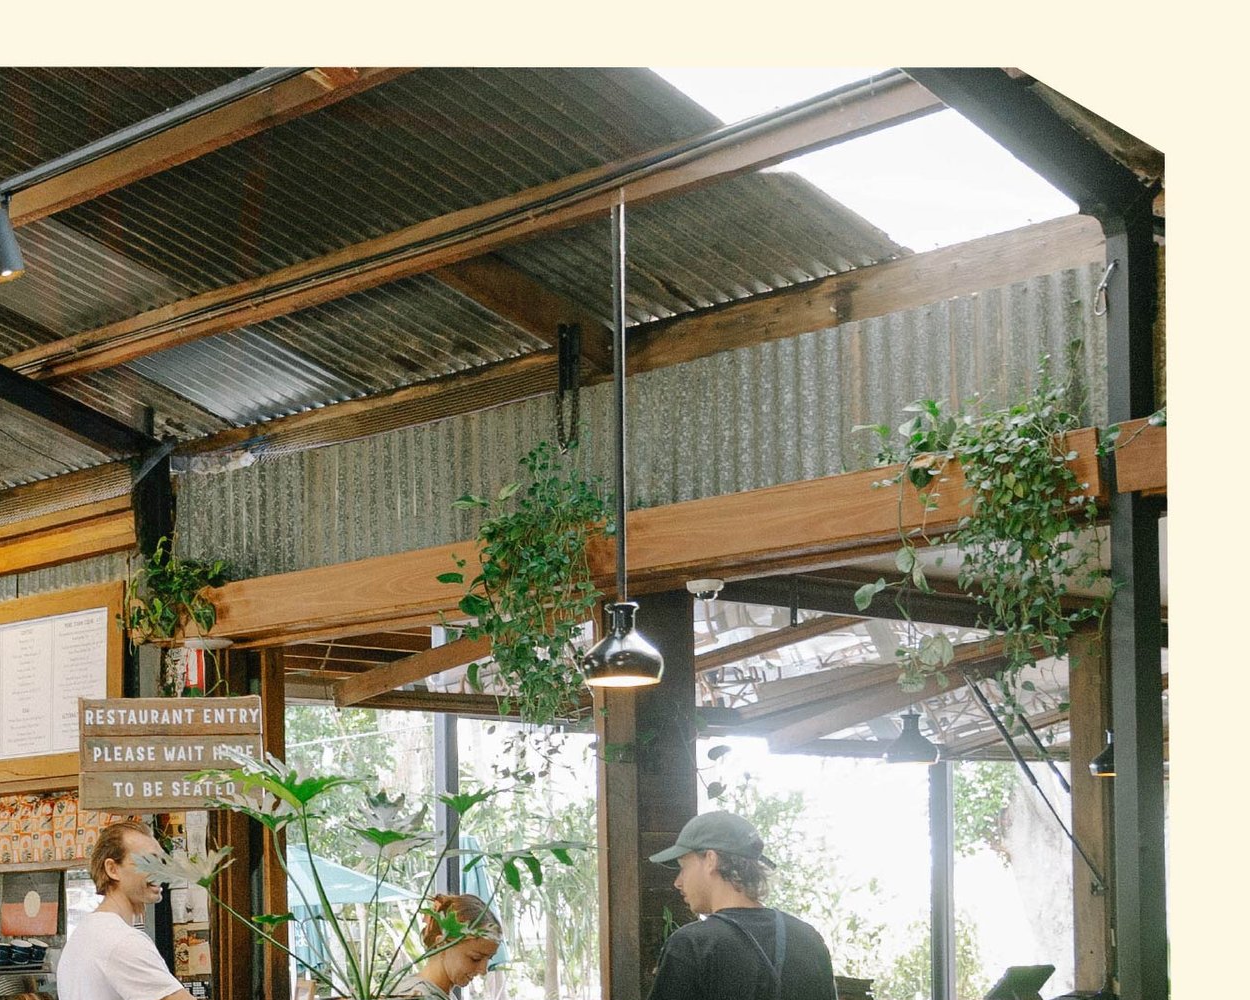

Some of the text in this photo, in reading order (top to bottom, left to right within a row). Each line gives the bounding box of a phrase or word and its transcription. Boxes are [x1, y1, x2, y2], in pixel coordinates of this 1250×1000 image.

[85, 708, 195, 726] RESTAURANT
[203, 707, 260, 724] ENTRY
[93, 746, 156, 762] PLEASE
[163, 745, 204, 762] WAIT
[113, 780, 236, 798] TO BE SEATED
